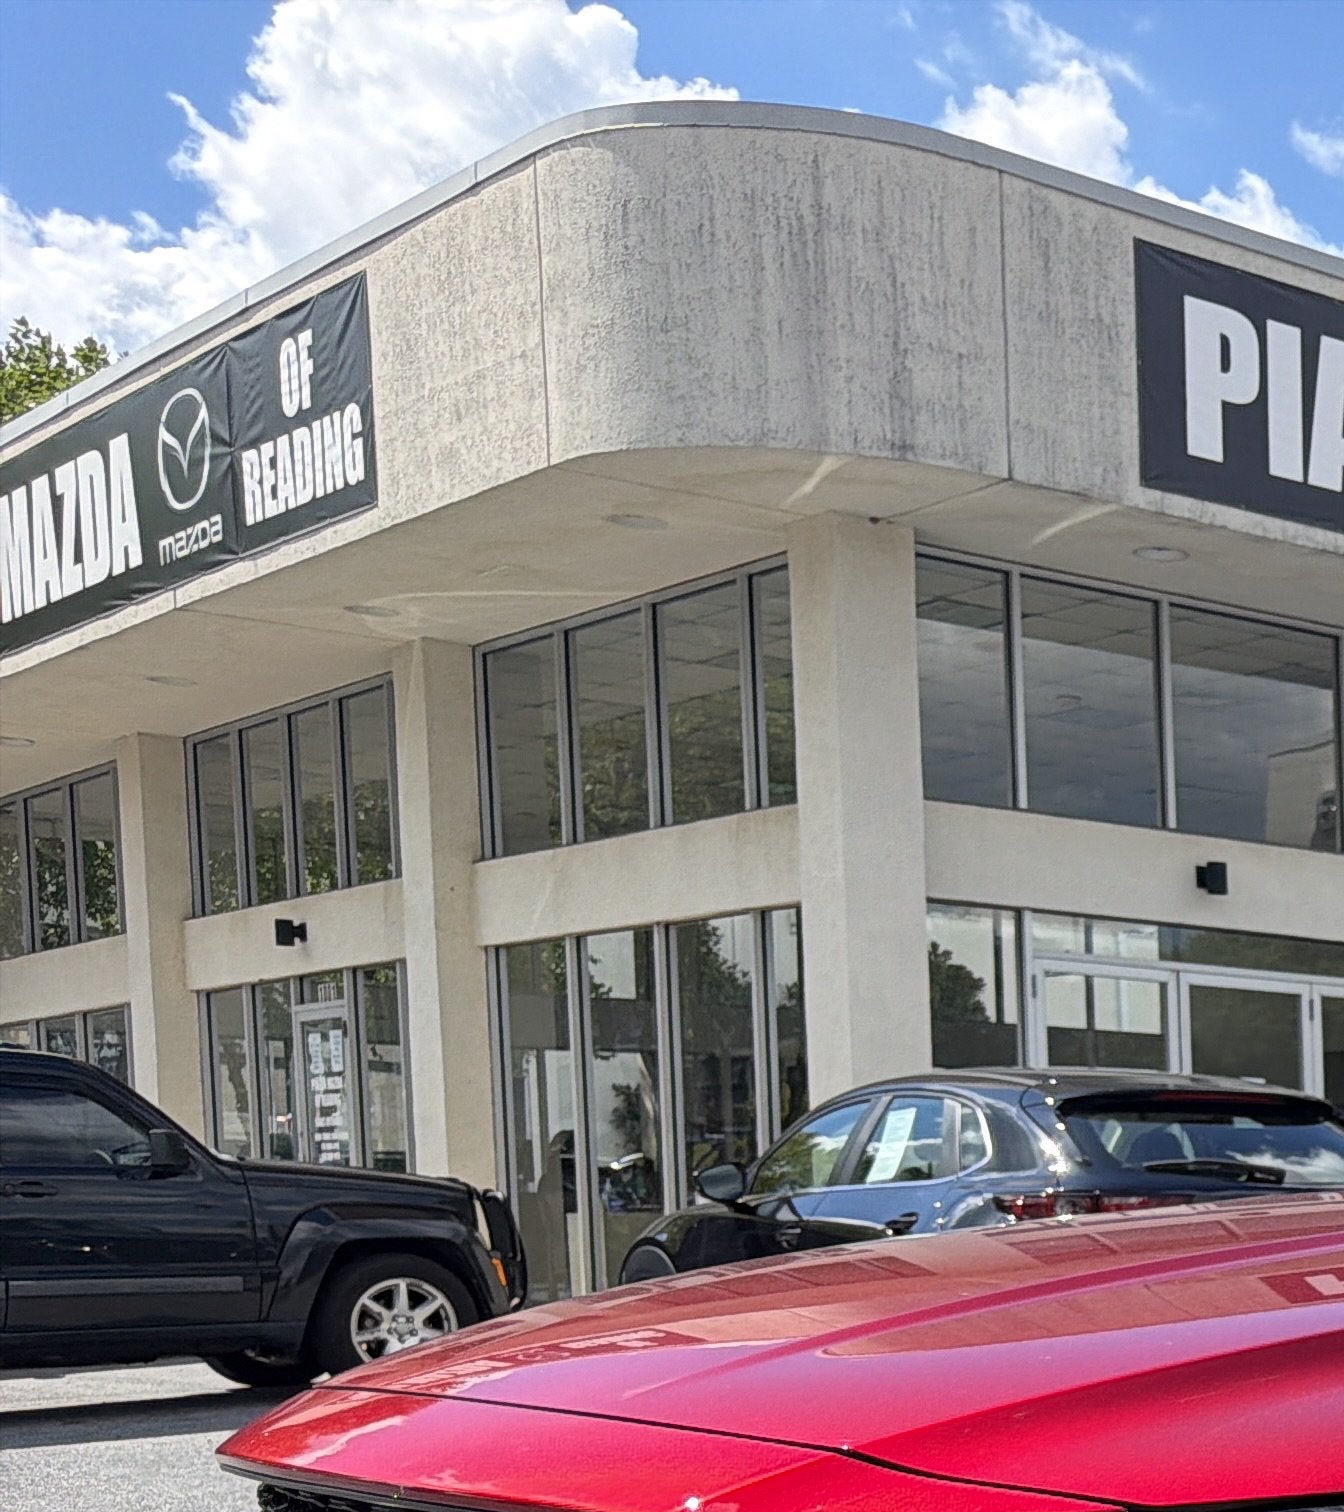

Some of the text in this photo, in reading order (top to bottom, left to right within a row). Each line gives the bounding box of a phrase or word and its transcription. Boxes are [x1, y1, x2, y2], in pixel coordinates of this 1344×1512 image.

[279, 329, 314, 418] OF
[241, 403, 366, 527] READING
[0, 432, 143, 624] MAZDA
[158, 513, 224, 567] mazda
